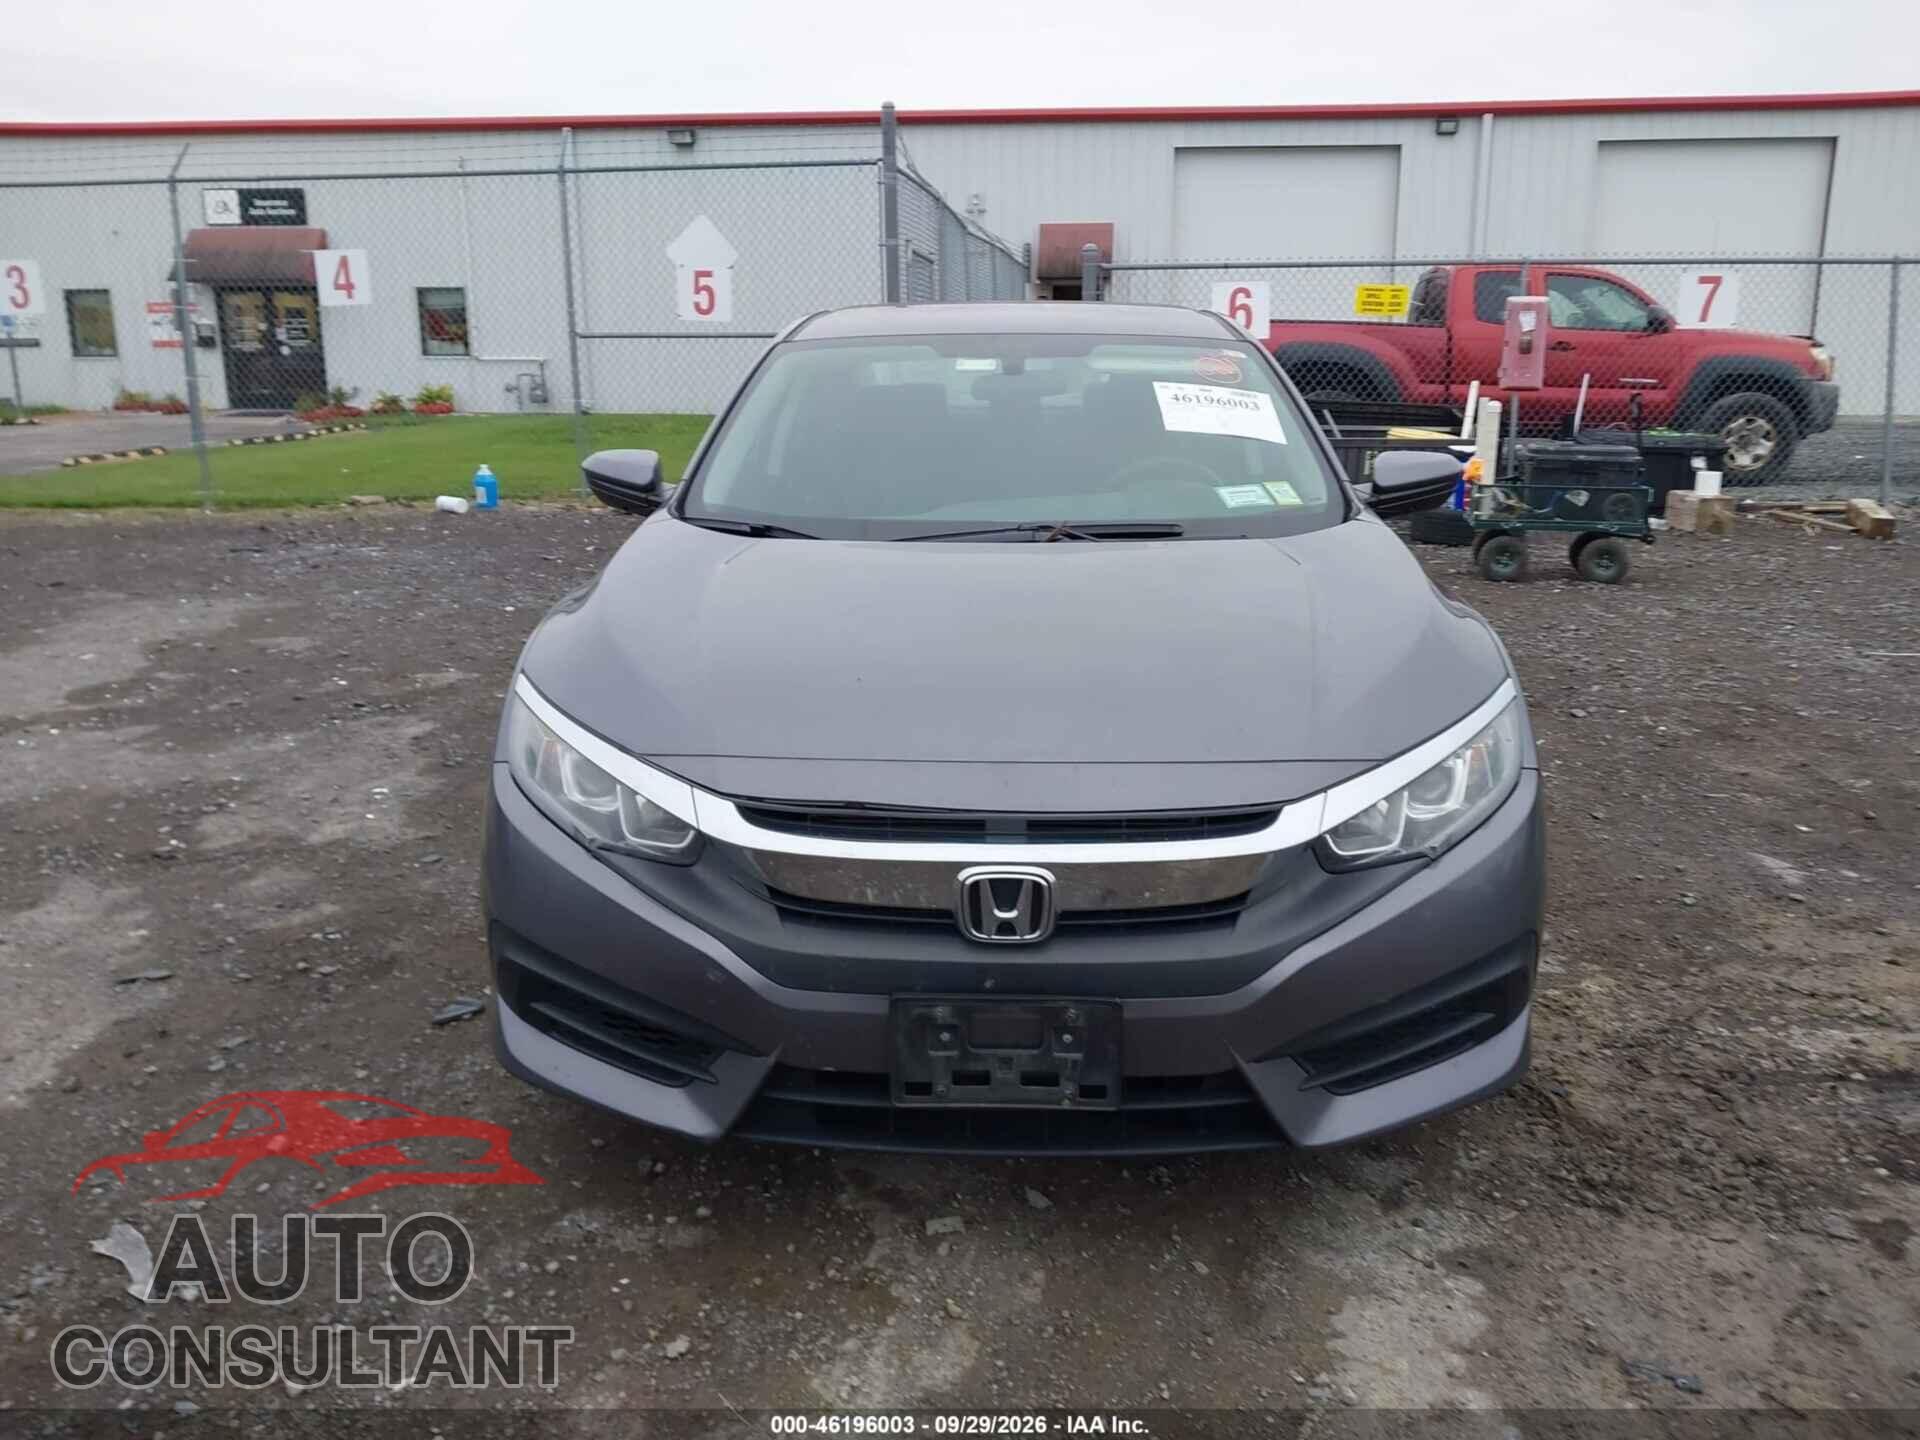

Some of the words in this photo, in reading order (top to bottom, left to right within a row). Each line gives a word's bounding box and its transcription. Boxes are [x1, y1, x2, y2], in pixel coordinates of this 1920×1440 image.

[6, 265, 29, 309] 3
[333, 255, 355, 299] 4
[693, 270, 715, 316] 5
[1697, 275, 1723, 322] 7
[1229, 286, 1253, 330] 6
[1169, 392, 1261, 411] 46196003
